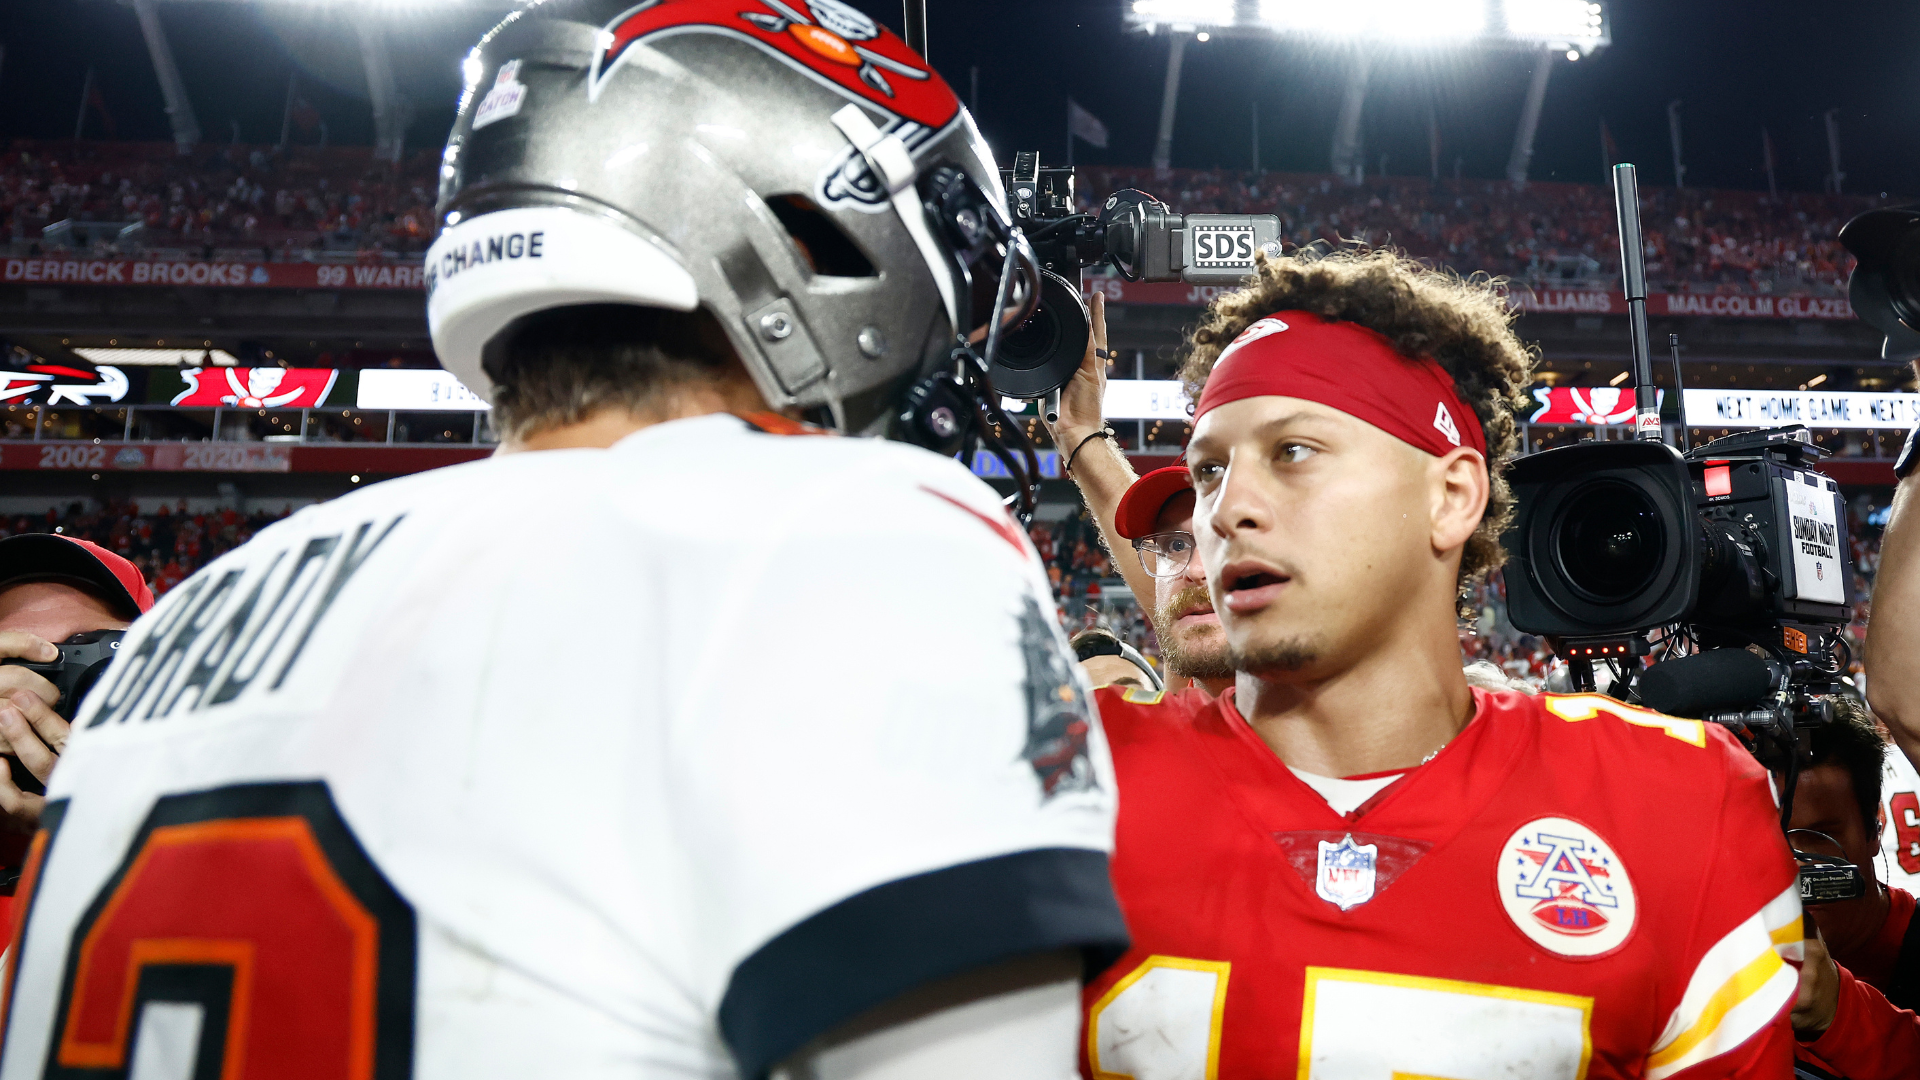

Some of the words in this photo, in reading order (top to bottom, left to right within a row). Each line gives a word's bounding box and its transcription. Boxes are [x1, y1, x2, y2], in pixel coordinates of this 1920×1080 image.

[441, 231, 544, 279] CHANGE
[1197, 233, 1252, 259] SDS
[5, 260, 125, 281] DERRICK
[132, 262, 246, 285] BROOKS
[317, 266, 347, 287] 99
[1667, 295, 1774, 316] MALCOLM
[1716, 396, 1751, 419] NEXT
[1760, 397, 1802, 420] HOME
[1809, 398, 1851, 421] GAME
[1870, 399, 1904, 422] NEXT
[39, 446, 106, 468] 2002
[183, 448, 249, 470] 2020
[1793, 515, 1818, 543] SUNDAY
[1818, 521, 1836, 547] NIGHT
[1801, 541, 1834, 559] FOOTBALL
[86, 513, 409, 730] BRADY
[1556, 908, 1589, 926] LH
